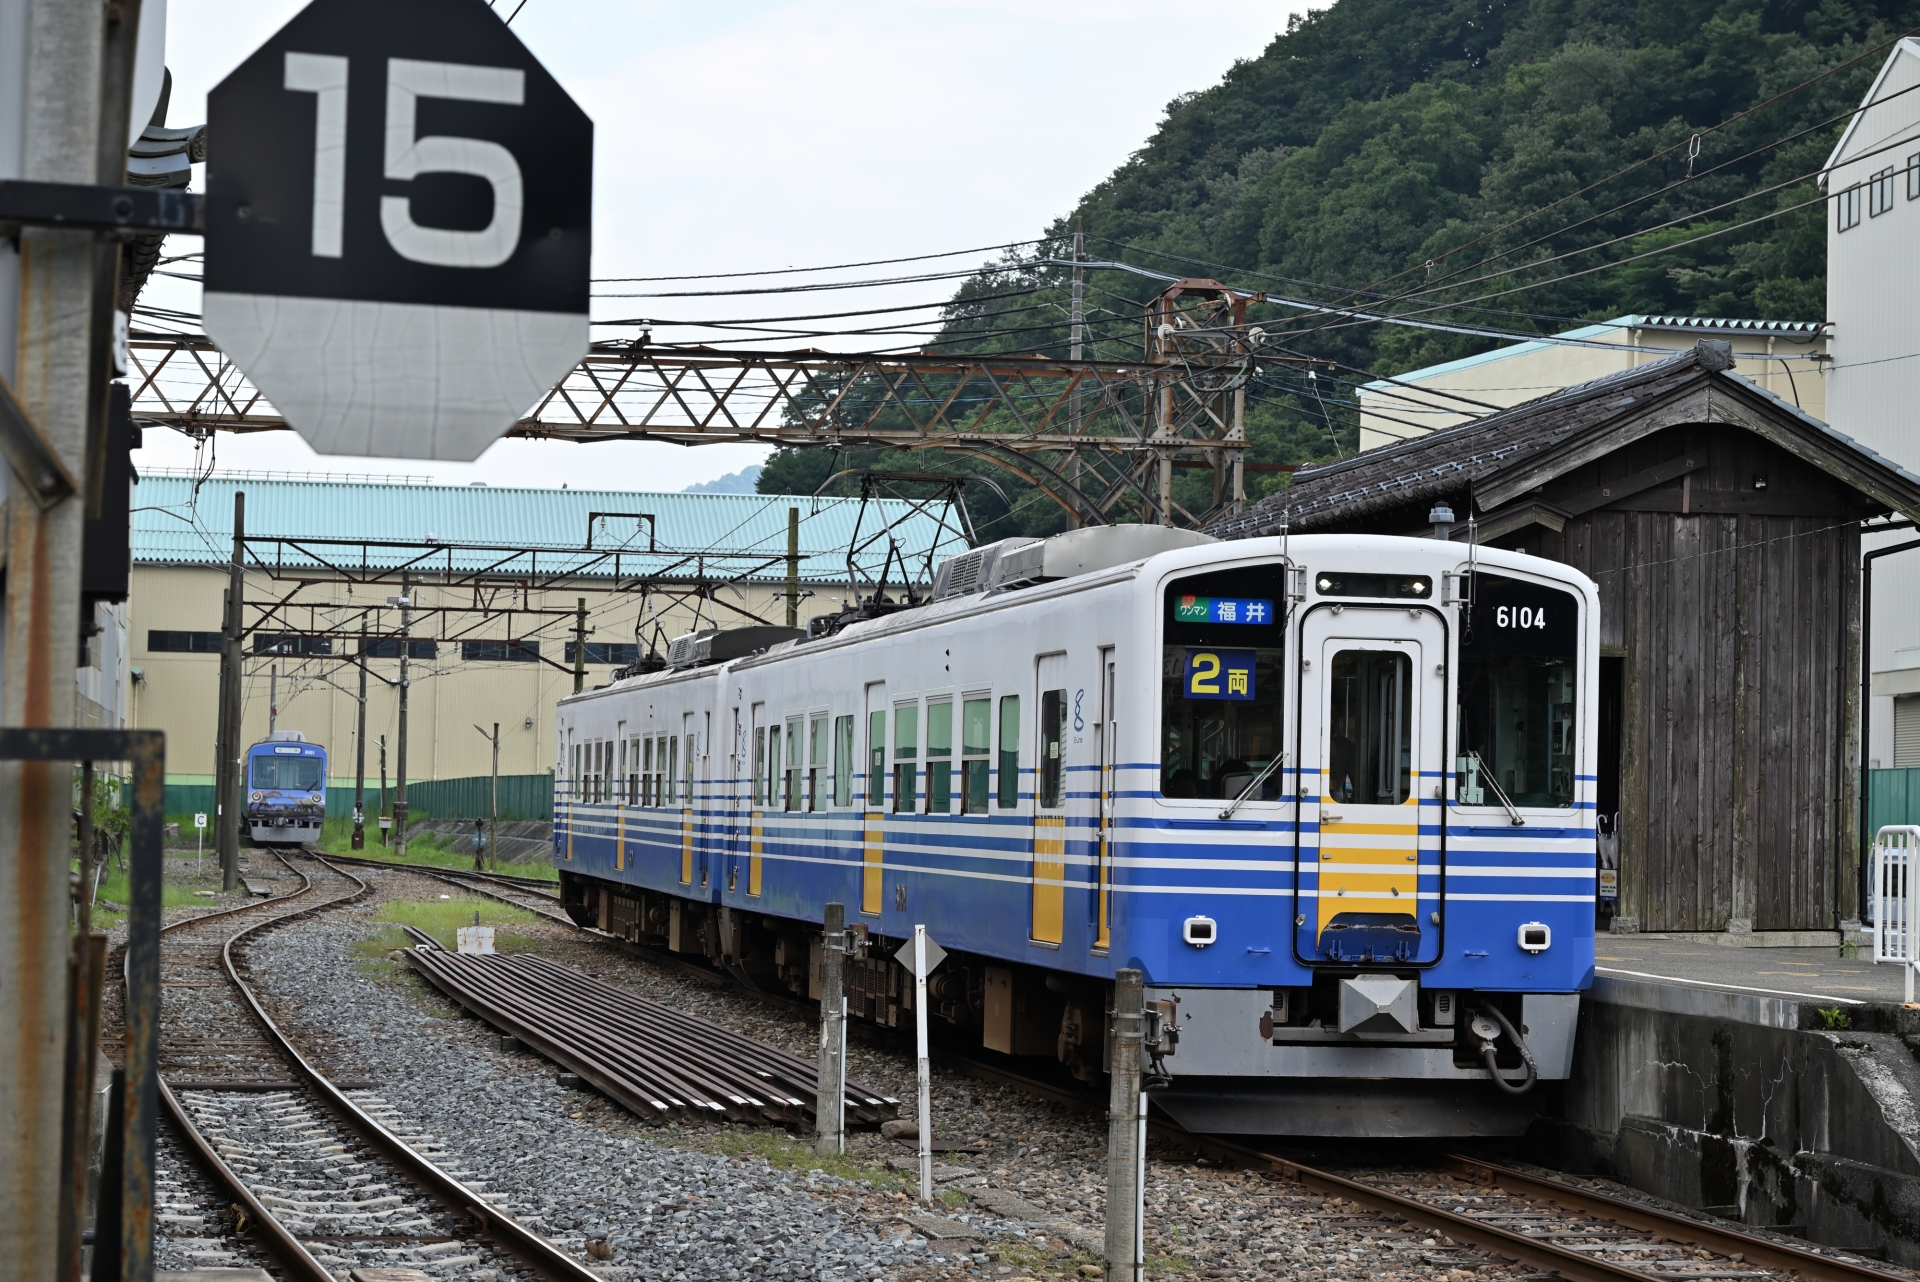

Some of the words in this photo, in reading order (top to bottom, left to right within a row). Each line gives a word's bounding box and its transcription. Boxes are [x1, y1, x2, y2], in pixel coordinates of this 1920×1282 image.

[284, 52, 525, 268] 15
[1180, 605, 1207, 616] ワンマン
[1217, 601, 1265, 622] 福井
[1496, 605, 1546, 629] 6104
[197, 815, 205, 825] C
